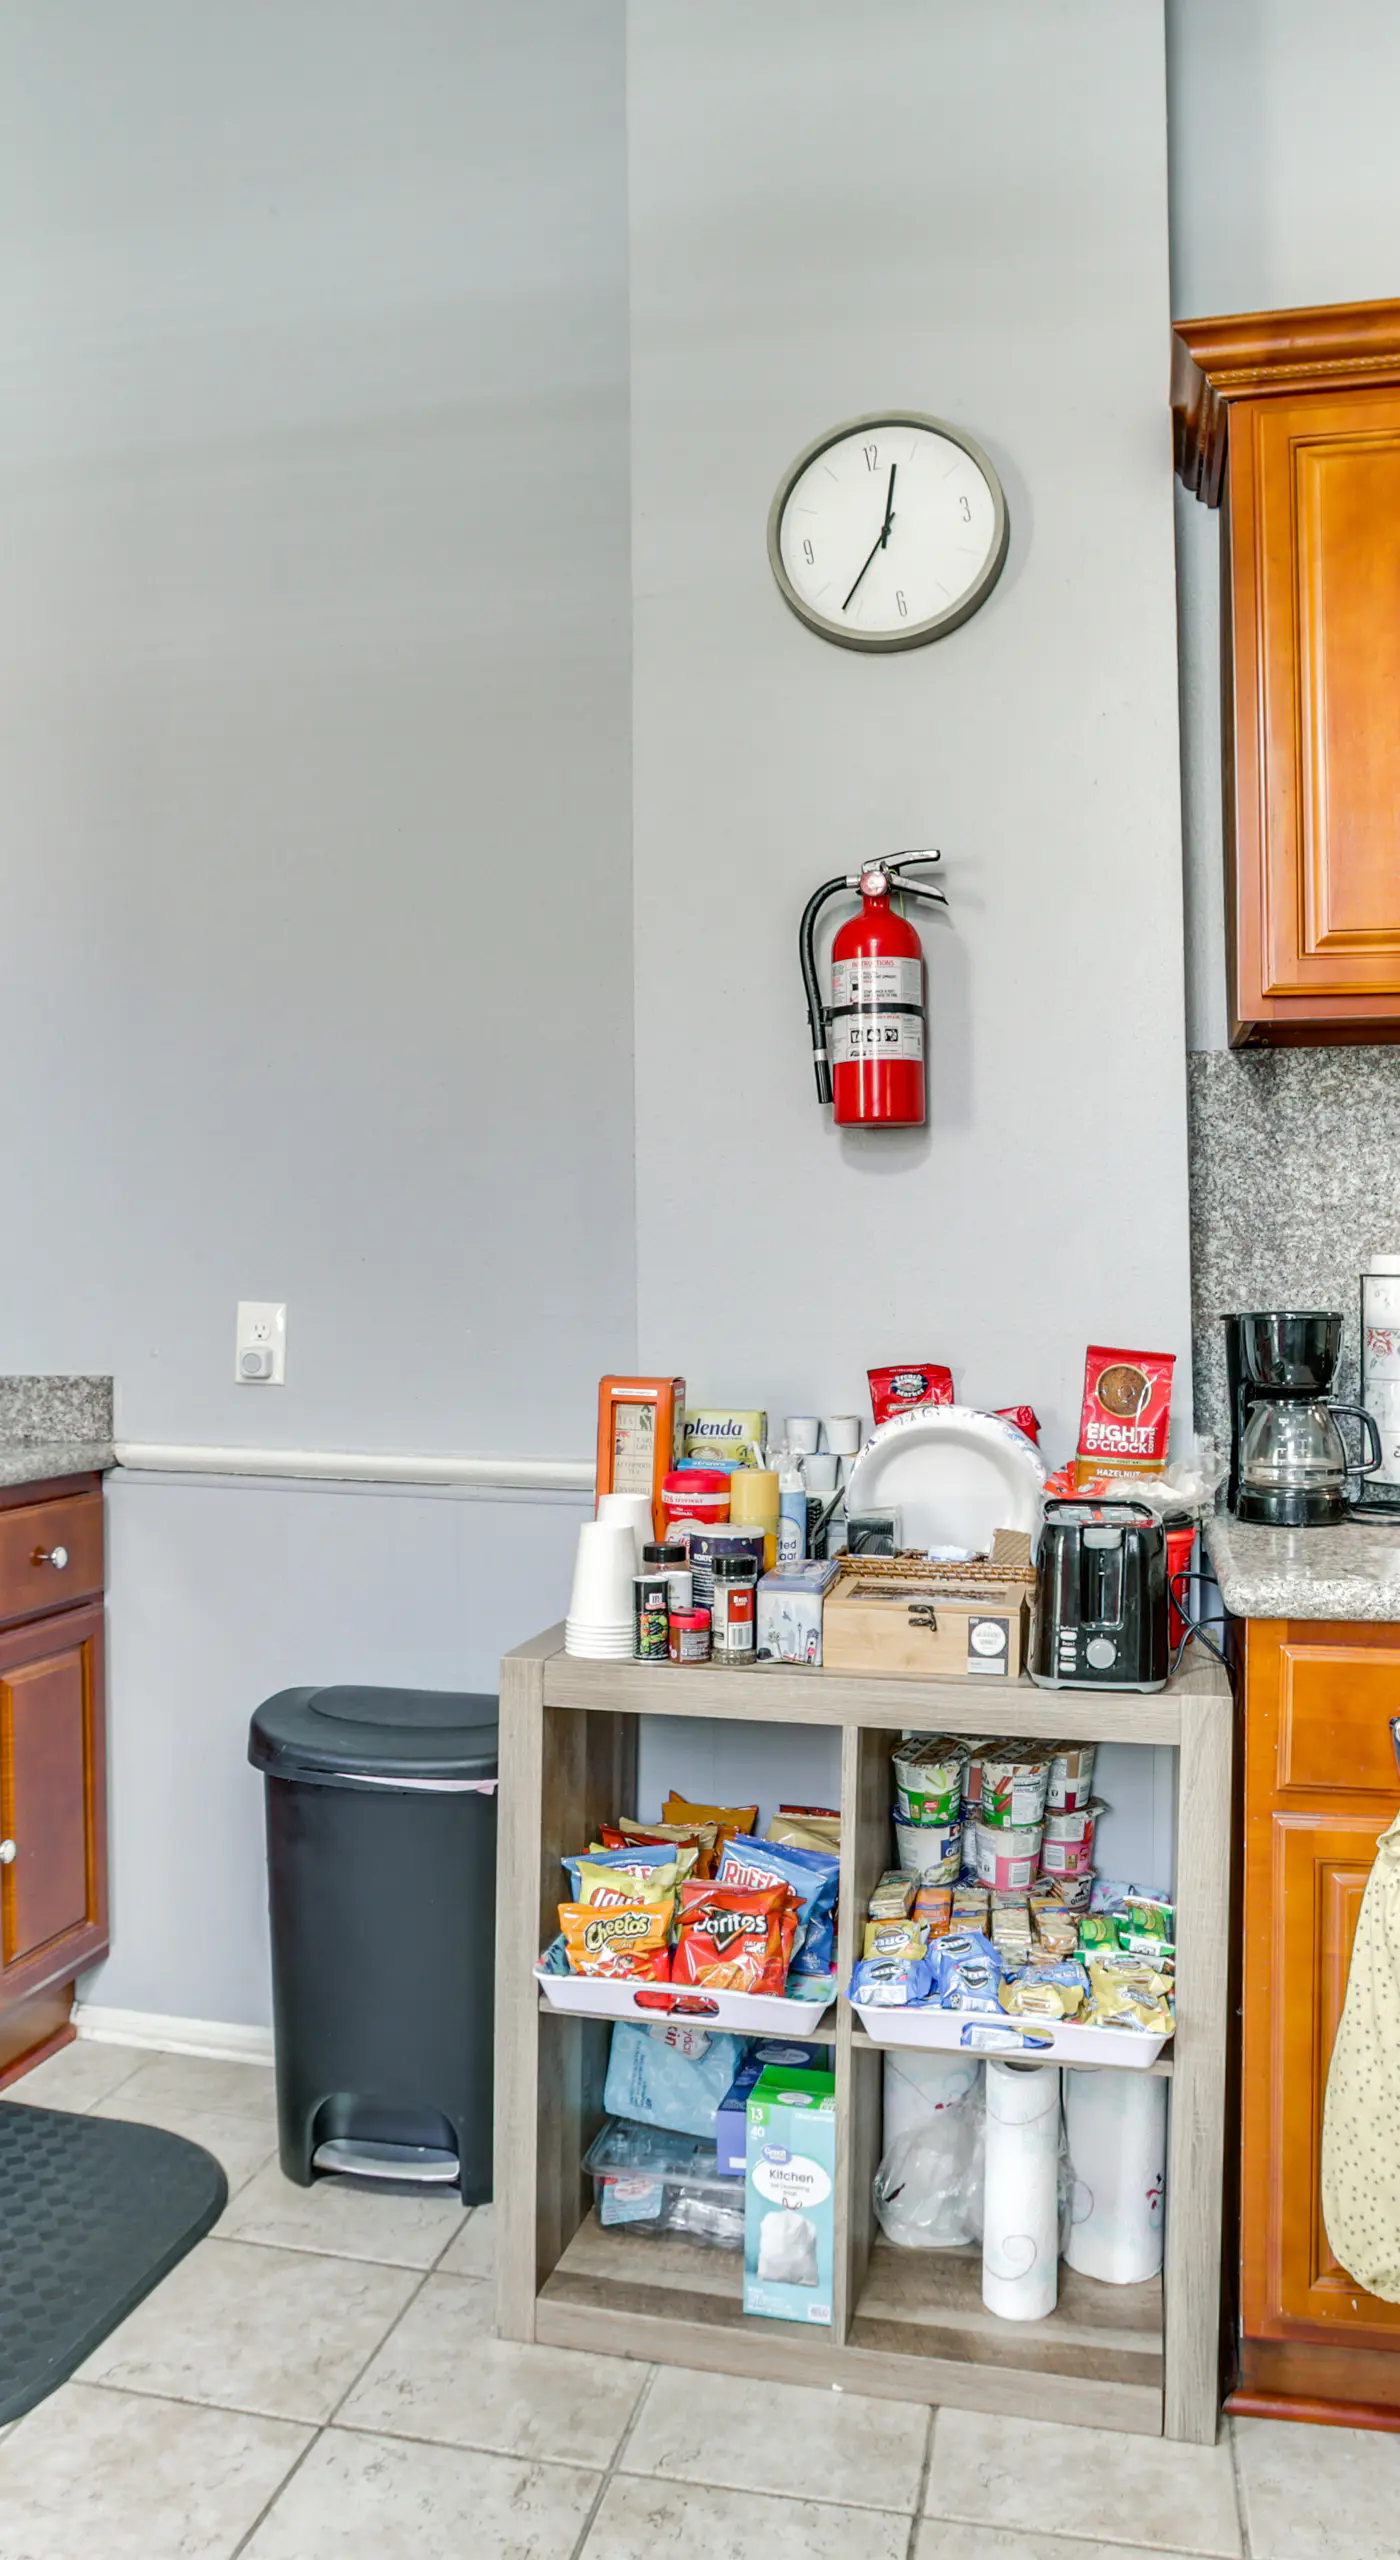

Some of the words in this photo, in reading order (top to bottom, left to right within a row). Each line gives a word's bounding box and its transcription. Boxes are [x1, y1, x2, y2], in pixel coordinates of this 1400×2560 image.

[863, 445, 881, 471] 12
[959, 496, 971, 523] 3
[803, 539, 815, 565] 9
[896, 590, 908, 617] 6
[851, 959, 895, 968] INTRUTIONS
[684, 1418, 743, 1440] plenda
[1086, 1422, 1150, 1443] EIGHT
[1086, 1439, 1148, 1454] O'CLOCK
[1096, 1468, 1141, 1478] HAZELNUT
[724, 1859, 797, 1896] RUFFL
[584, 1912, 651, 1953] Cheetos
[693, 1914, 768, 1934] Doritos
[751, 2107, 764, 2121] 13
[750, 2125, 766, 2138] 40
[769, 2169, 814, 2184] Kitchen
